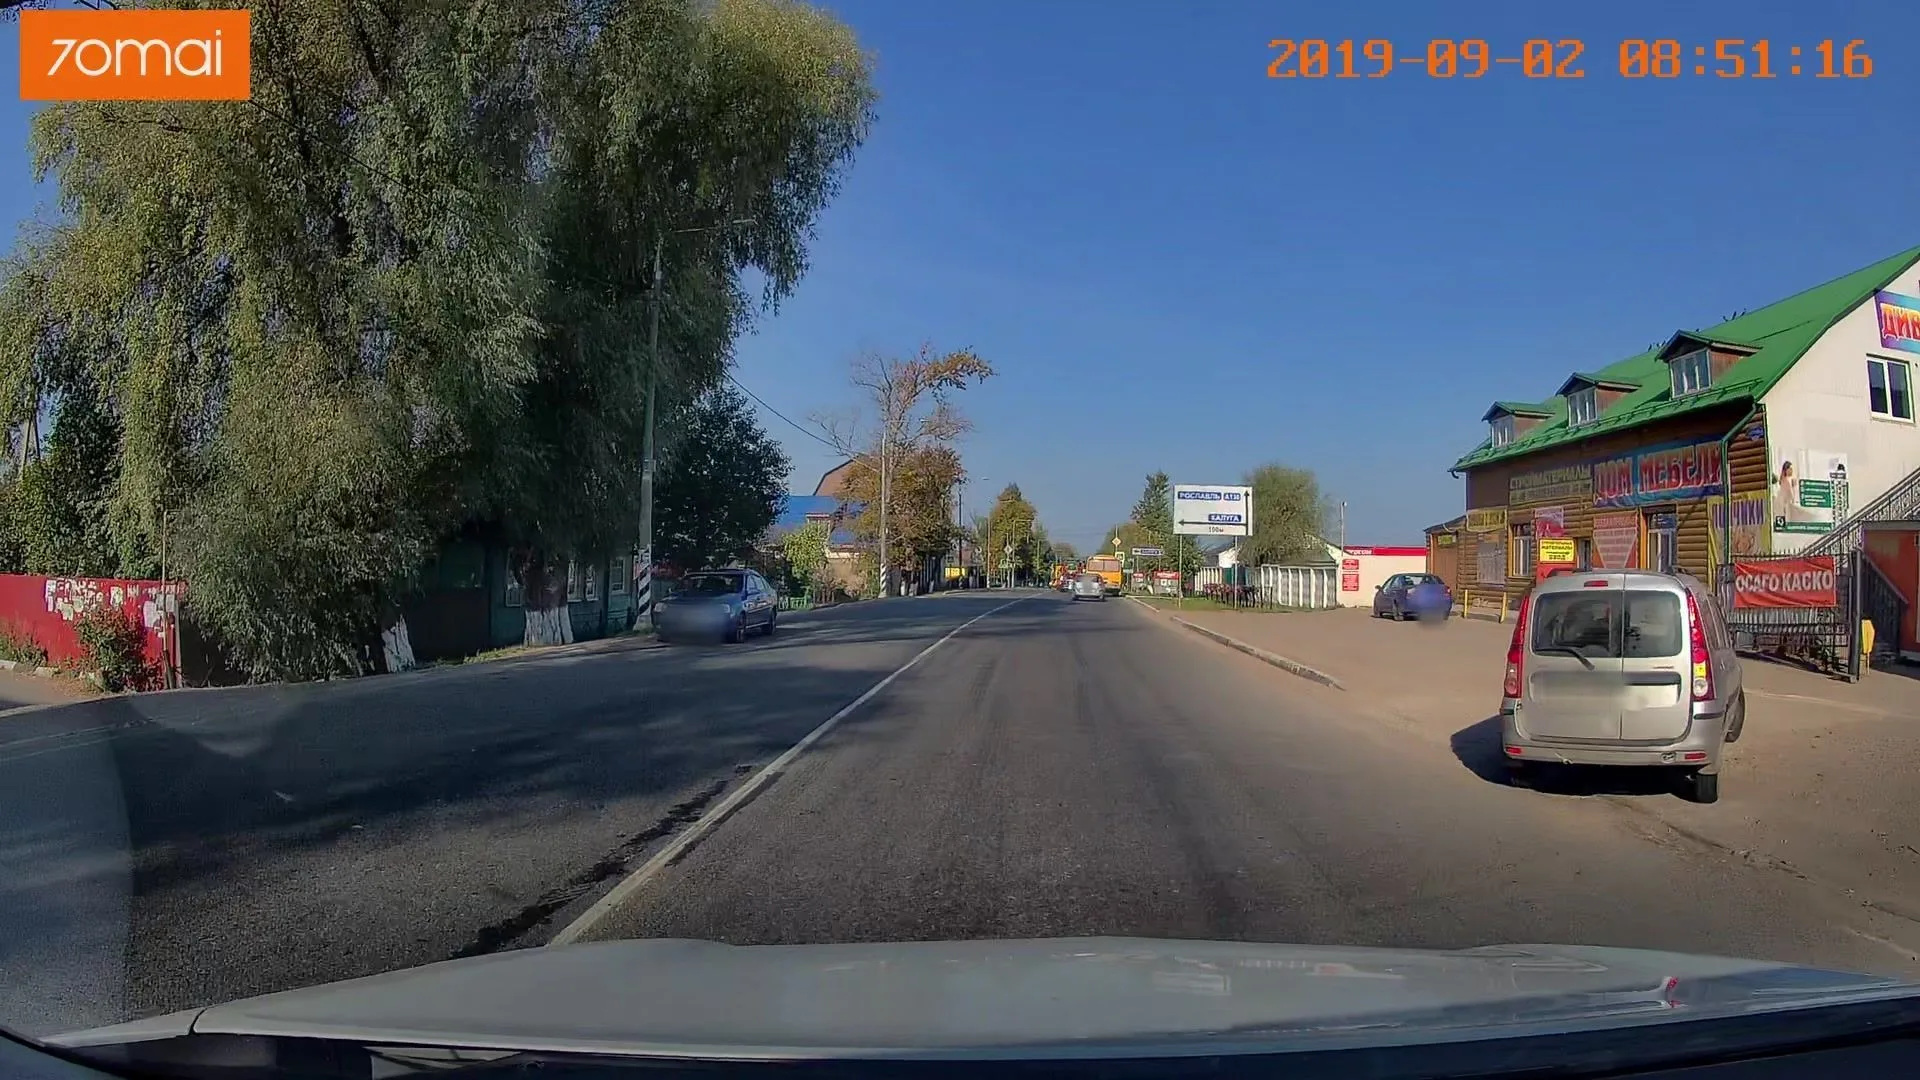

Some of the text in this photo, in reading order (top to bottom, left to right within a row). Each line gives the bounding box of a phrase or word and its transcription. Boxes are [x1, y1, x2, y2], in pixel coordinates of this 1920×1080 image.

[1593, 456, 1633, 505] ДОМ
[1638, 441, 1722, 494] МЕБЕЛИ
[1735, 569, 1834, 593] ОСАГО КАСКО
